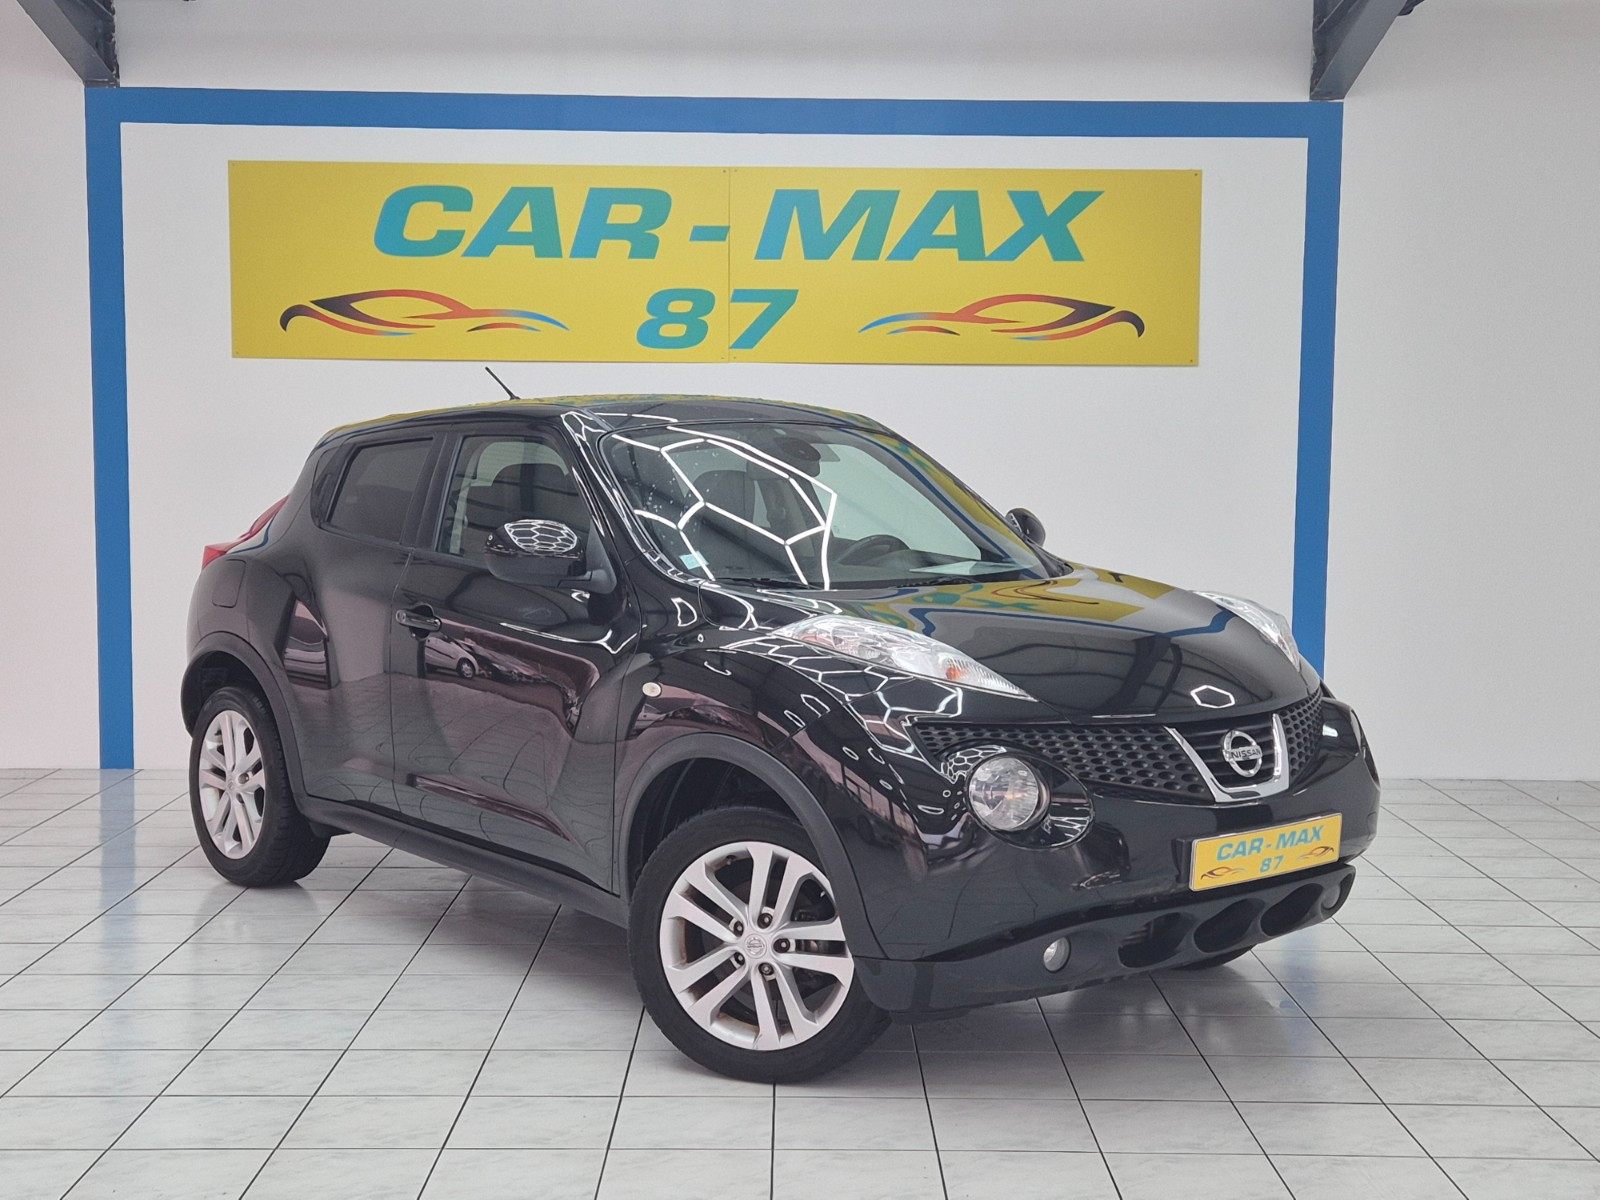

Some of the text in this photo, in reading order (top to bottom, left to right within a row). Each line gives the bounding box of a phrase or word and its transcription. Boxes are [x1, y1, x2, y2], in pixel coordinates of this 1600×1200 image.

[636, 287, 799, 350] 87
[1231, 748, 1261, 759] NISSAN
[1259, 855, 1284, 874] 87
